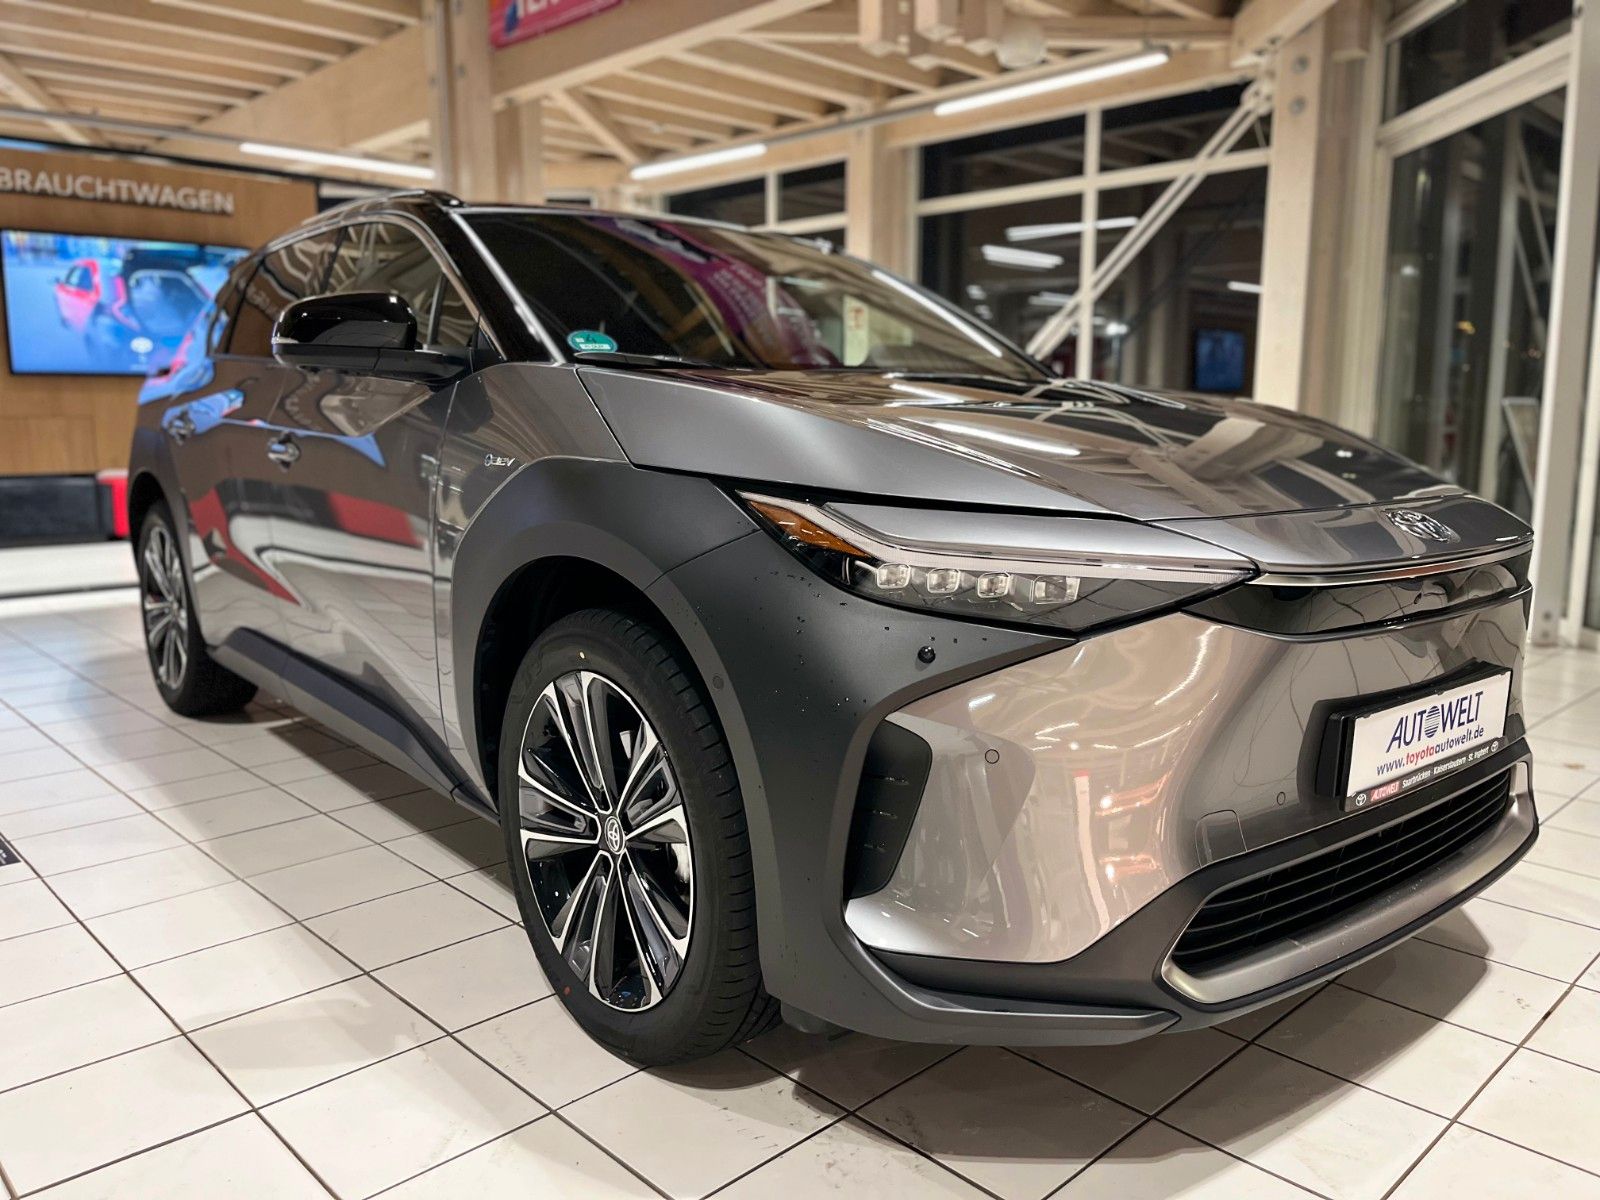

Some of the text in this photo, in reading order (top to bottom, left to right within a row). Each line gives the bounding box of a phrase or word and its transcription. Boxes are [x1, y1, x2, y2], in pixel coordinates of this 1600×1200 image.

[0, 167, 234, 213] BRAUCHTWAGEN
[1385, 691, 1483, 753] AUTOWELT
[1376, 725, 1484, 776] www.toyotaautowelt.de
